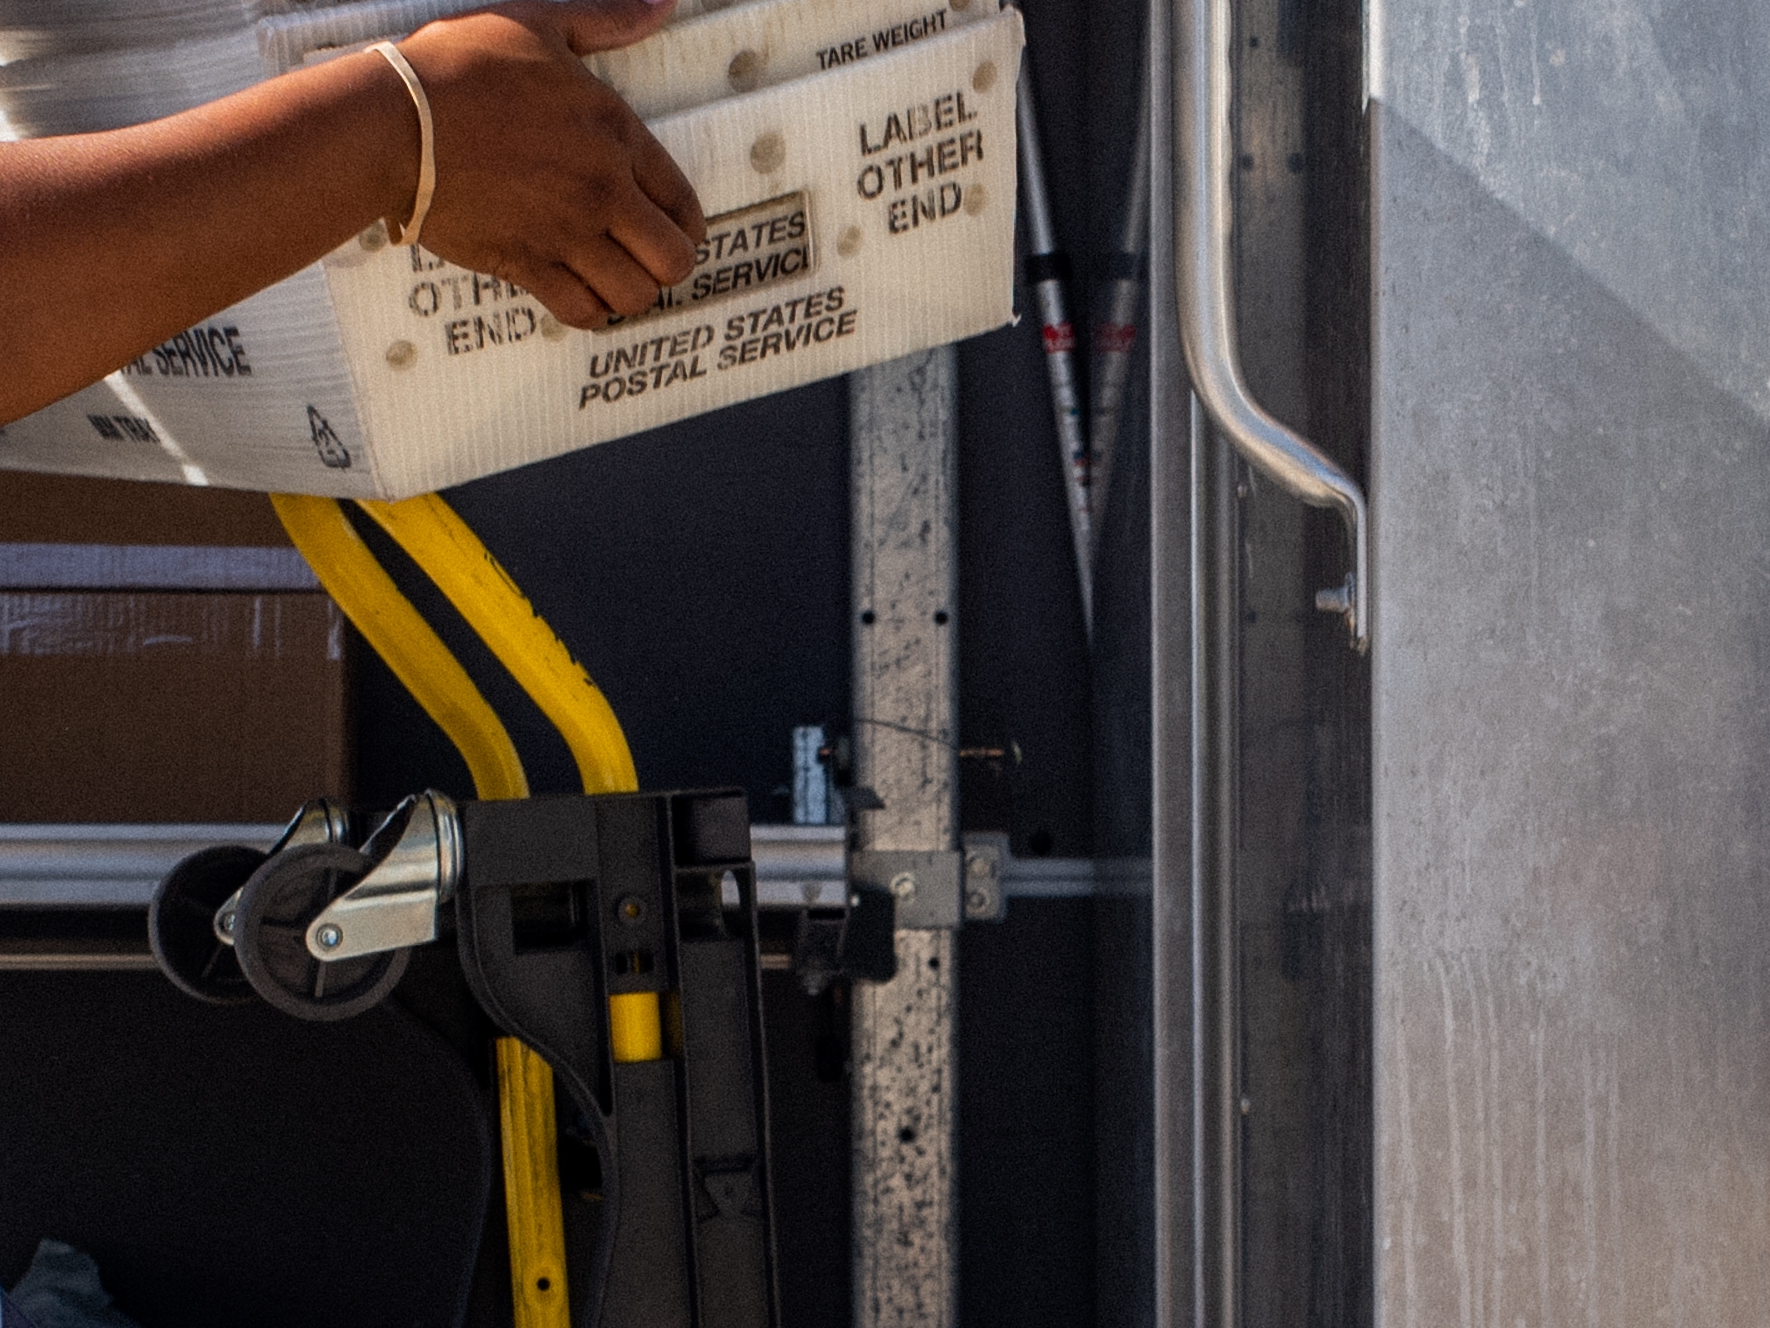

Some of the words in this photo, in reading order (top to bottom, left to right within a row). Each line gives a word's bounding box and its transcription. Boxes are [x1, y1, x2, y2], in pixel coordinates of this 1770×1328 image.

[815, 38, 865, 71] TARE
[871, 9, 948, 56] WEIGHT
[859, 90, 977, 155] LABEL
[856, 129, 985, 201] OTHER
[695, 210, 806, 266] STATES
[888, 182, 963, 235] END
[407, 272, 529, 318] OTH
[445, 306, 536, 356] END
[579, 355, 707, 409] POSTAL
[717, 309, 858, 370] SERVICE
[590, 324, 715, 379] UNITED
[724, 285, 845, 342] STATES
